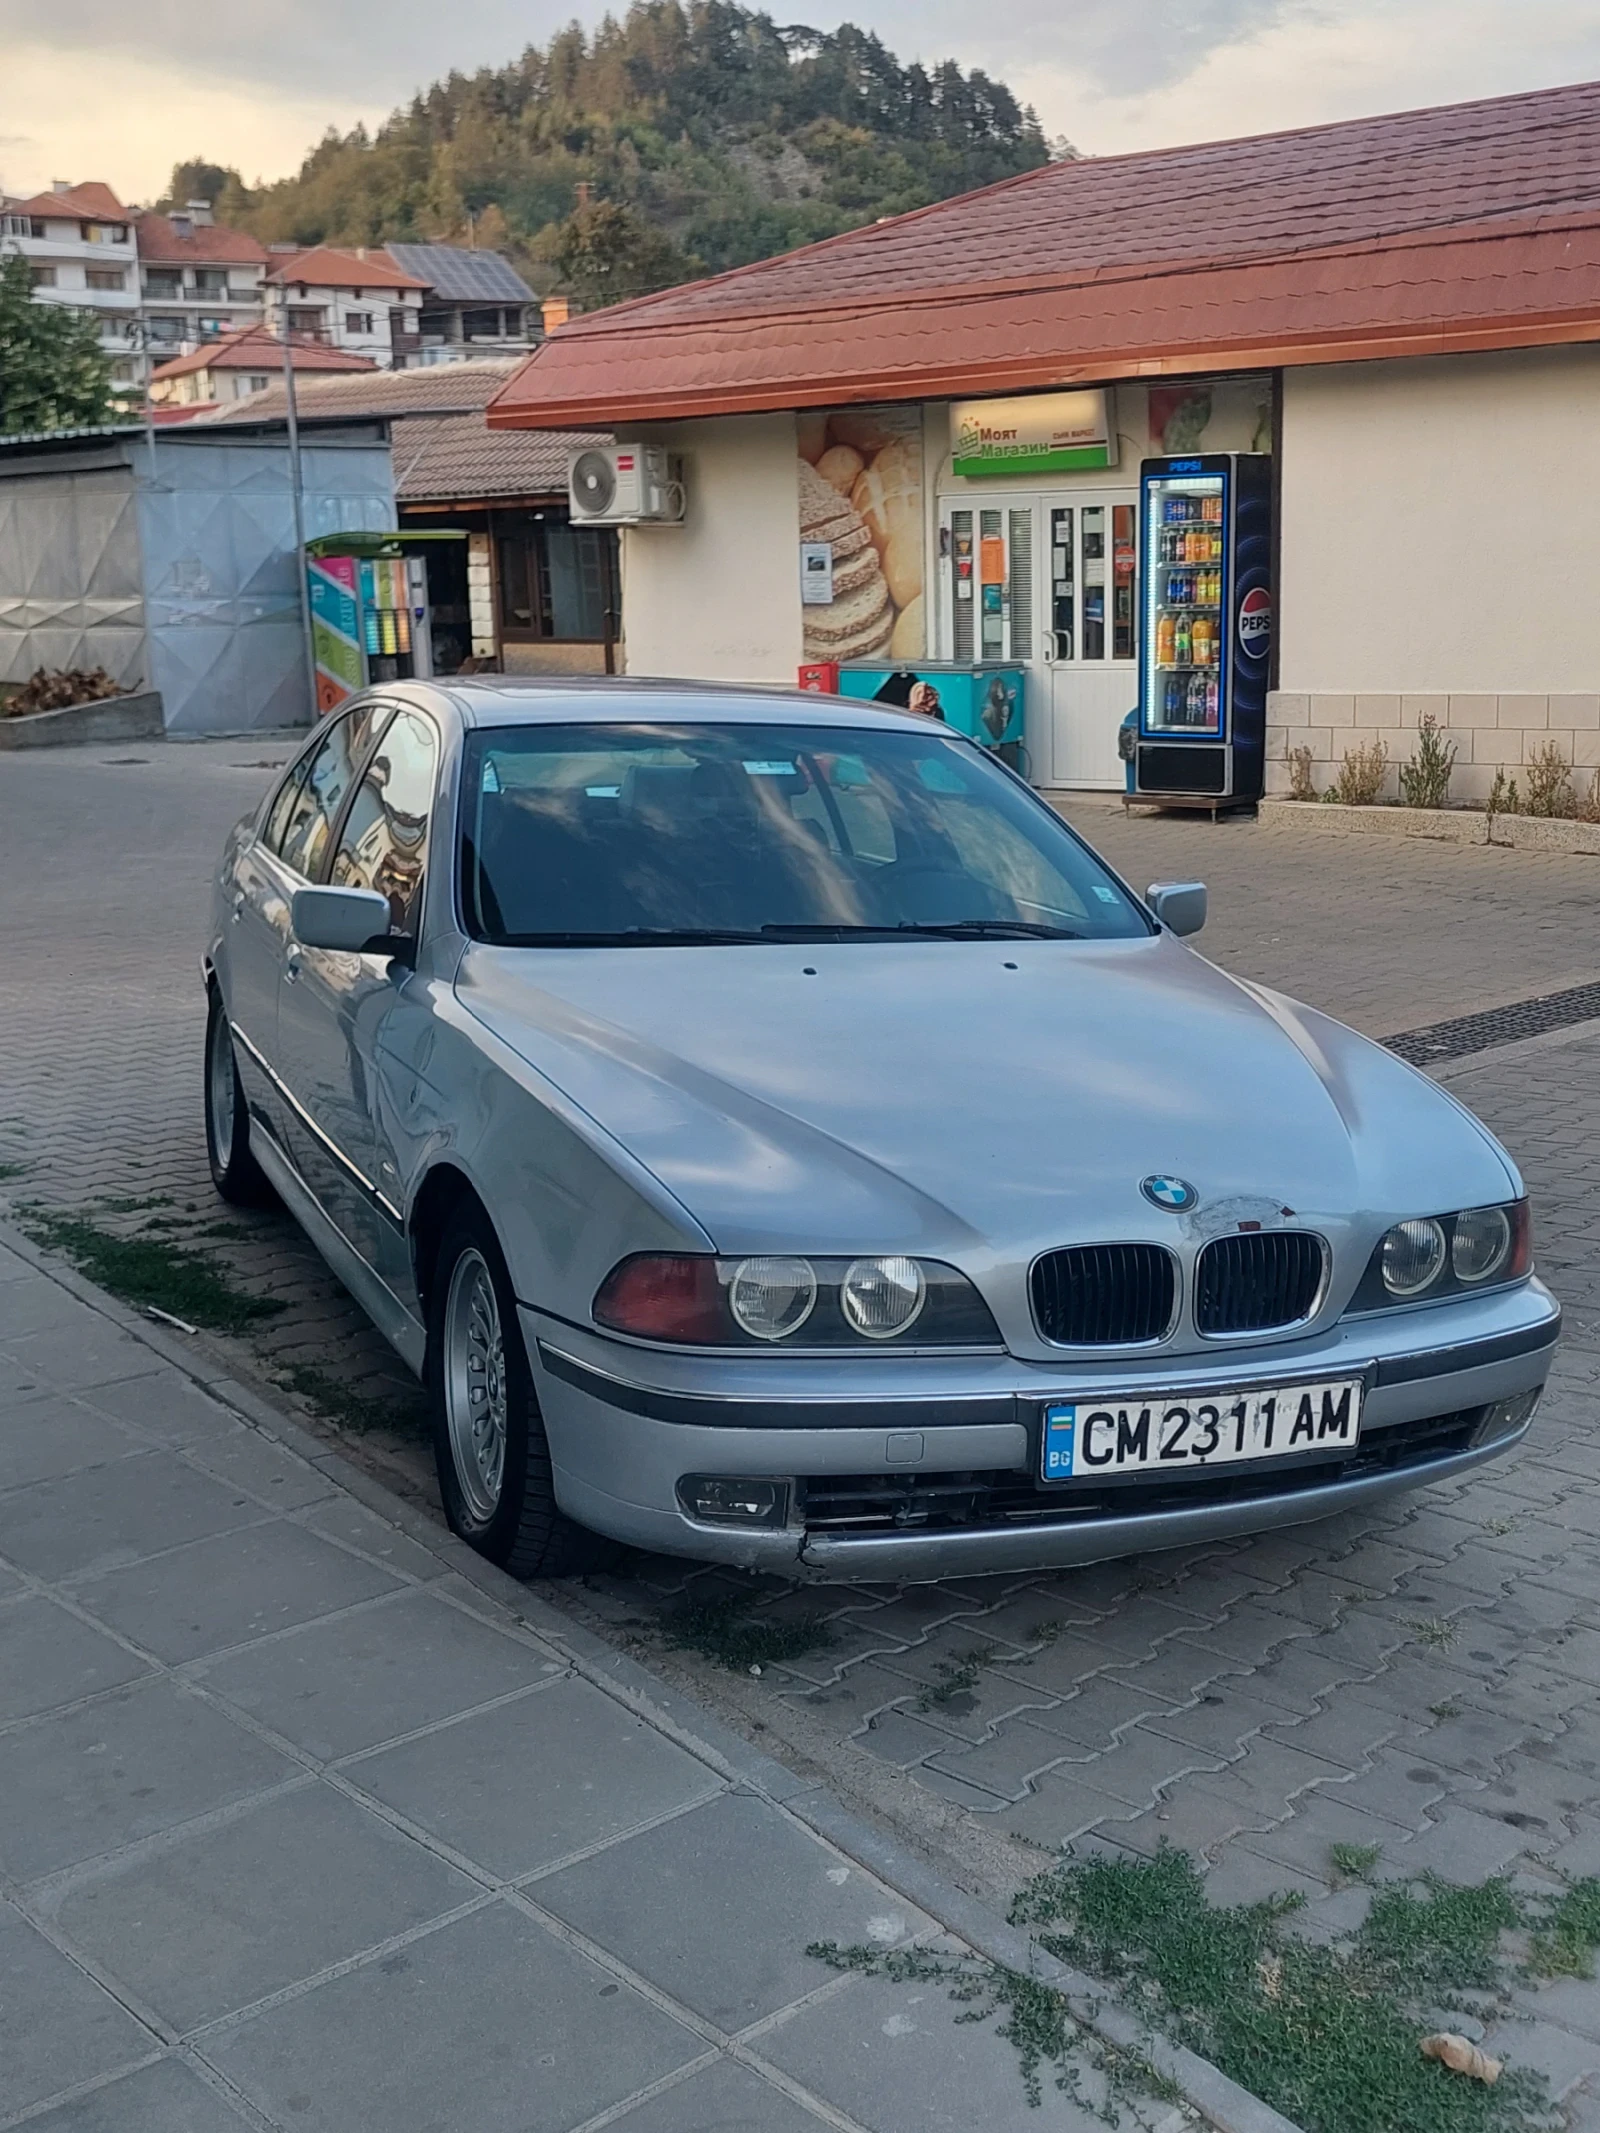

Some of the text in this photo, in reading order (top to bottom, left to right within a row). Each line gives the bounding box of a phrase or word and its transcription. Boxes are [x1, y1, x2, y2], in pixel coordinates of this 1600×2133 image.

[979, 428, 1018, 442] Моят
[980, 442, 1049, 458] Магазин
[1169, 460, 1202, 471] PEPSI
[1241, 615, 1271, 631] PEPS
[1049, 1451, 1071, 1468] BG
